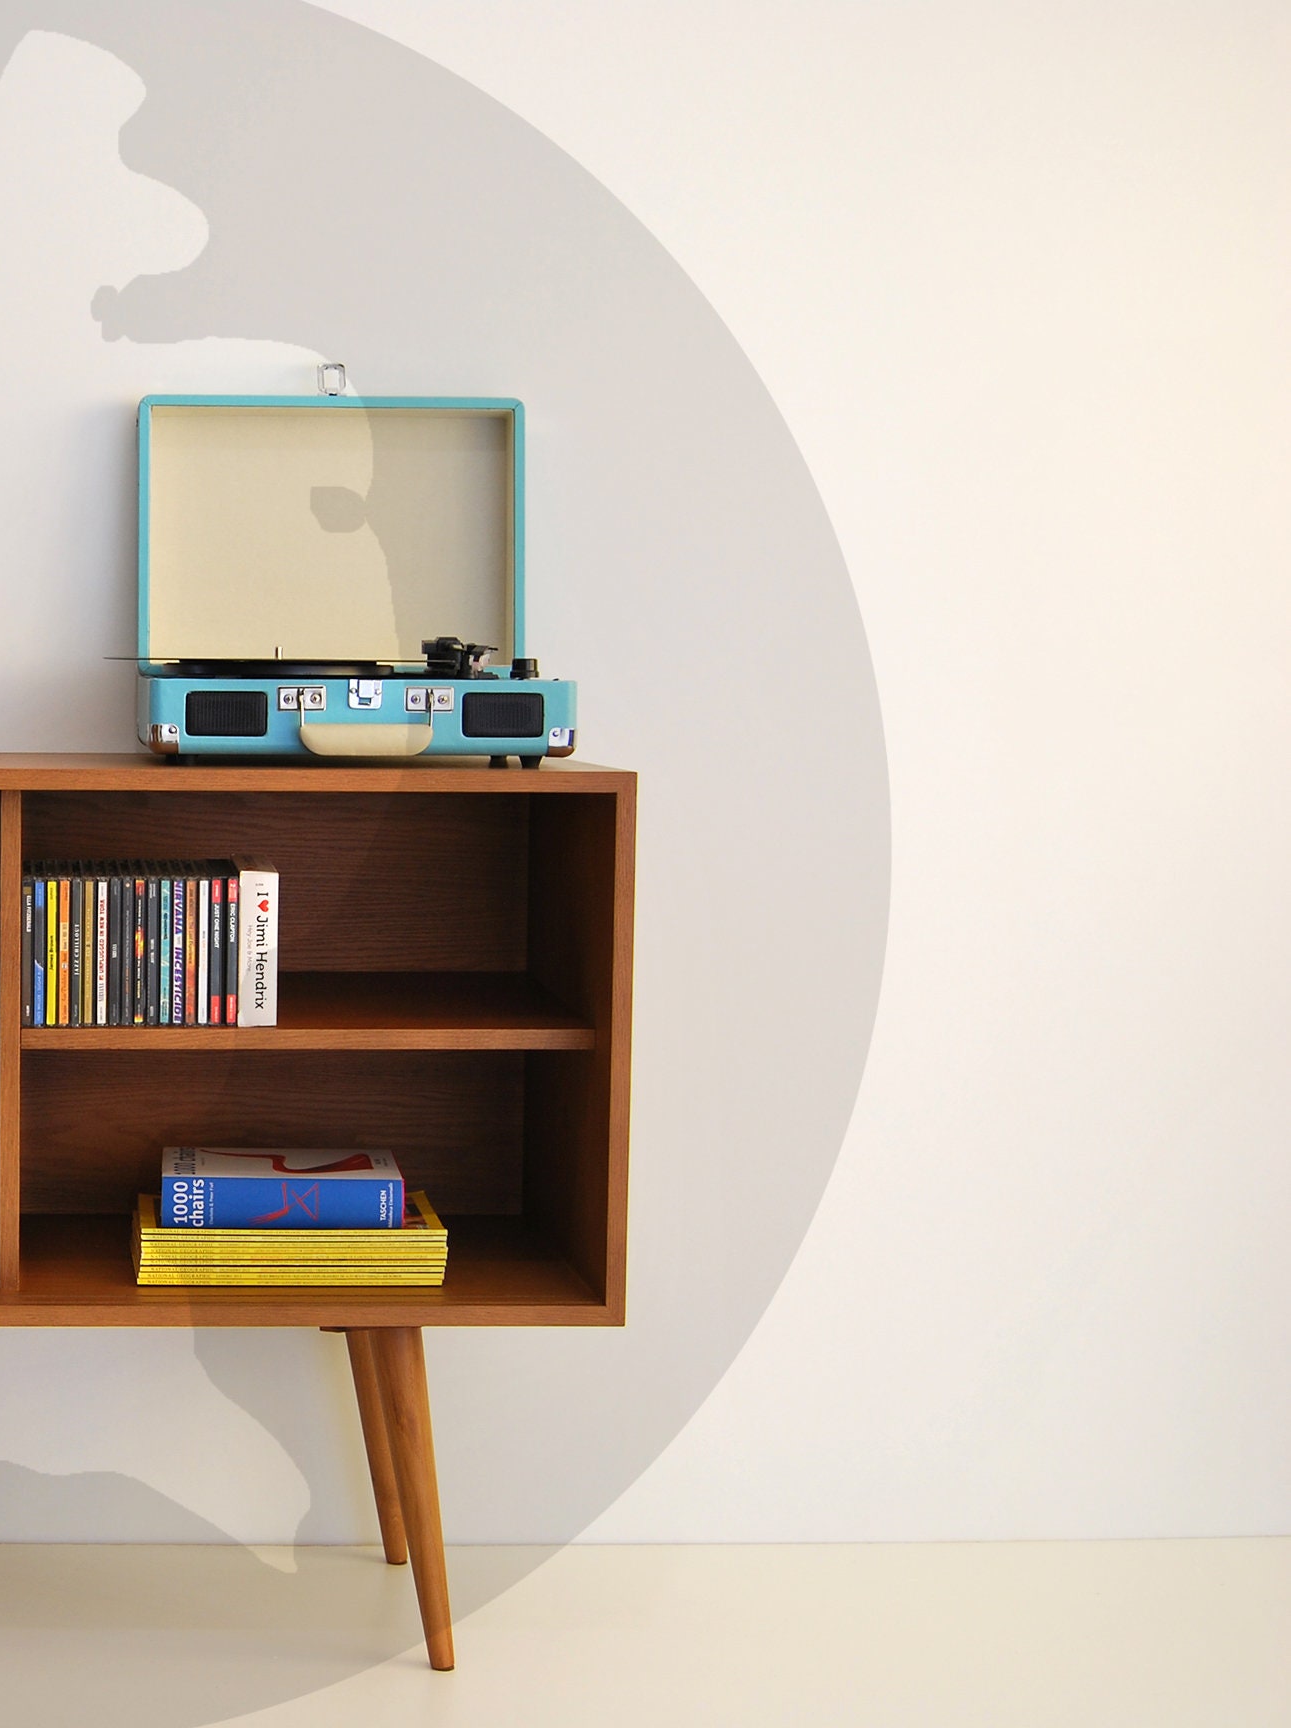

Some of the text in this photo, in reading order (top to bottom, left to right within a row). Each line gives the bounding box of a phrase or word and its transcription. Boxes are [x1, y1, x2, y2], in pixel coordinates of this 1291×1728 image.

[175, 880, 183, 935] NIRVANA
[256, 915, 269, 947] Jimi
[174, 947, 182, 1021] INCESTICIDE
[255, 951, 268, 1009] Hendrix
[173, 1181, 188, 1223] 1000
[189, 1179, 204, 1227] chairs
